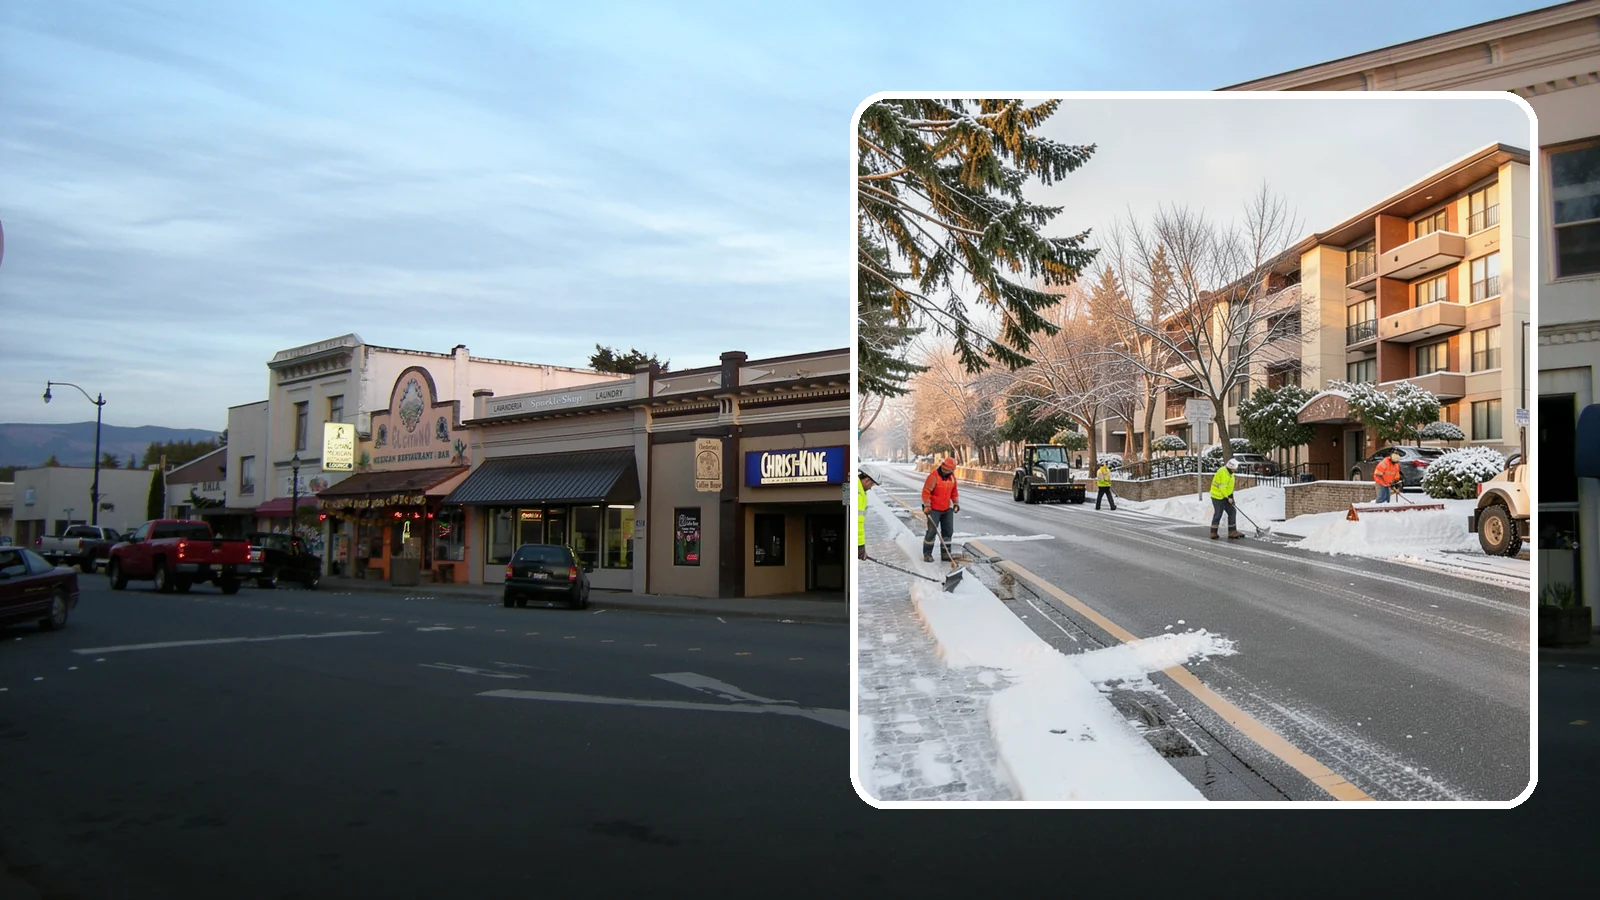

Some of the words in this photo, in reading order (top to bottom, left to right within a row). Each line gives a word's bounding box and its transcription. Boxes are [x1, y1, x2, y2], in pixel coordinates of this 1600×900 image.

[595, 389, 624, 400] LAUNDRY
[493, 402, 523, 412] LAVANDERIA
[531, 397, 561, 409] Sparkle
[562, 394, 582, 404] Shop
[374, 455, 396, 464] MEXICAN
[398, 452, 433, 462] RESTAURANT
[438, 451, 450, 459] BAR
[760, 452, 798, 478] CHRIST
[799, 450, 827, 476] KING
